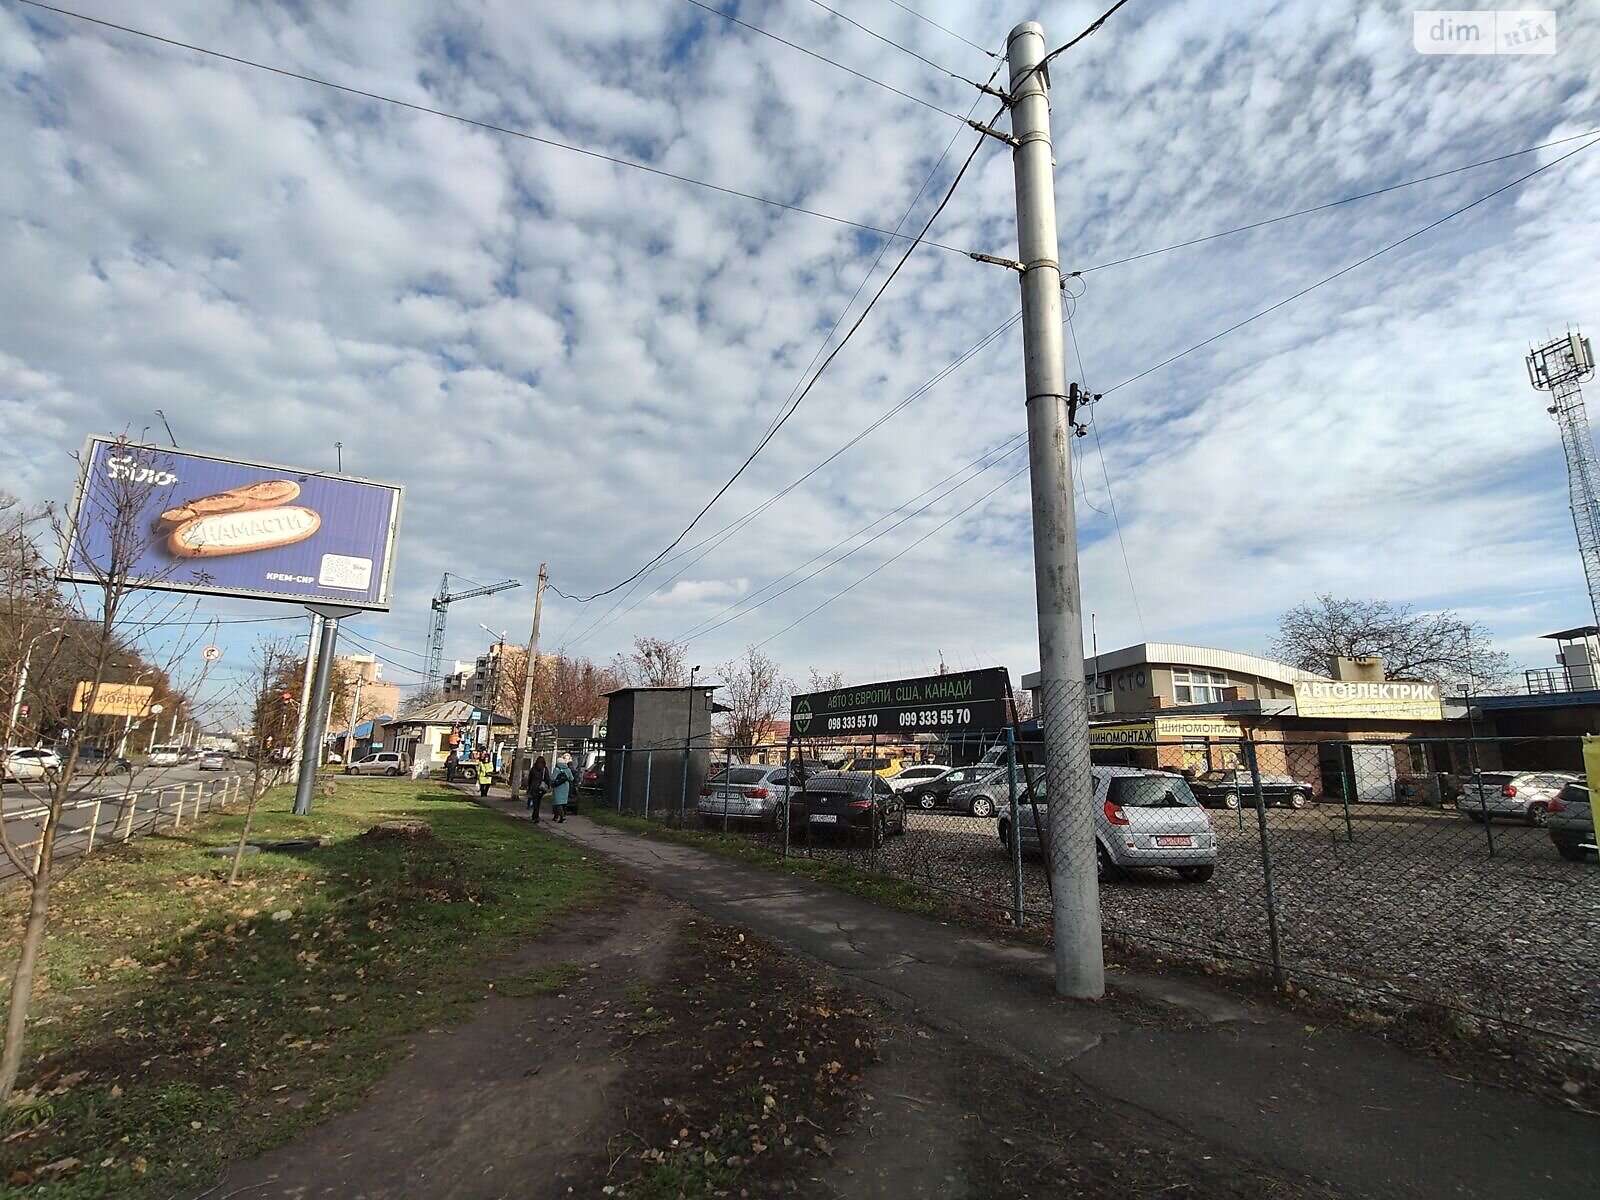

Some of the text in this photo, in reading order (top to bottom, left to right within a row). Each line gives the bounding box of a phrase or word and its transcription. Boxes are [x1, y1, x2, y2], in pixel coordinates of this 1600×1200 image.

[266, 572, 315, 584] КРЕМ-СИР
[1117, 671, 1146, 692] СТО
[827, 694, 847, 709] АВТО
[925, 679, 972, 699] КАНАДИ
[1301, 683, 1435, 700] АВТОЕЛЕКТРИК
[828, 713, 878, 730] 098 333 55 70
[900, 708, 971, 726] 099 333 55 70
[1162, 722, 1238, 734] ШИНОМОНТАЖ
